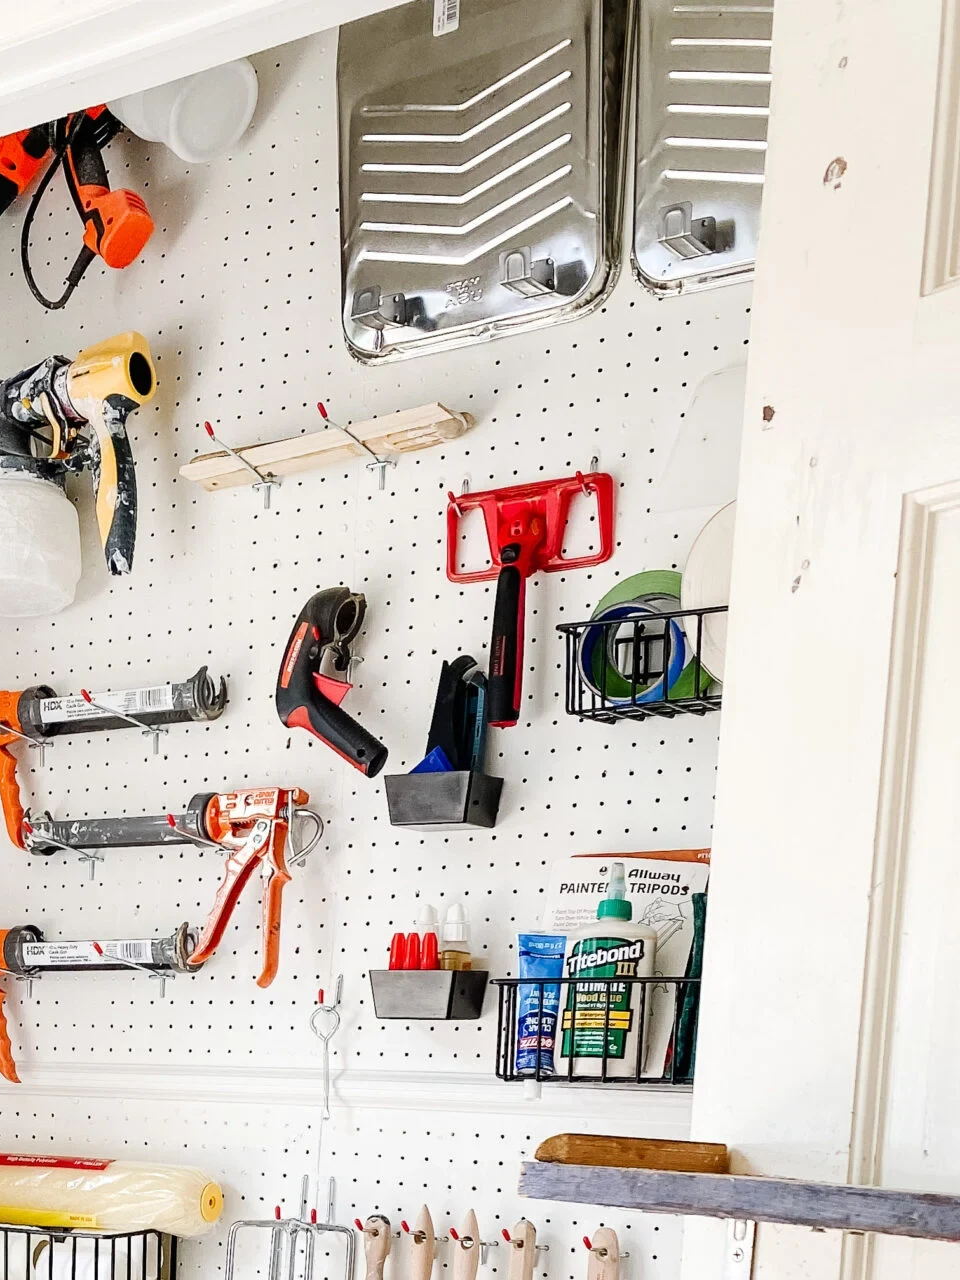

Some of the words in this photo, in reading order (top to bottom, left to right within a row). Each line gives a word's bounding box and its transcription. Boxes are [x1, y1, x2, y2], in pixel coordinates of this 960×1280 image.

[43, 700, 62, 712] HDX
[628, 869, 681, 883] Allway
[629, 882, 690, 896] TRIPODS
[26, 945, 45, 956] HDX
[567, 942, 642, 973] Titebond
[616, 961, 636, 976] III
